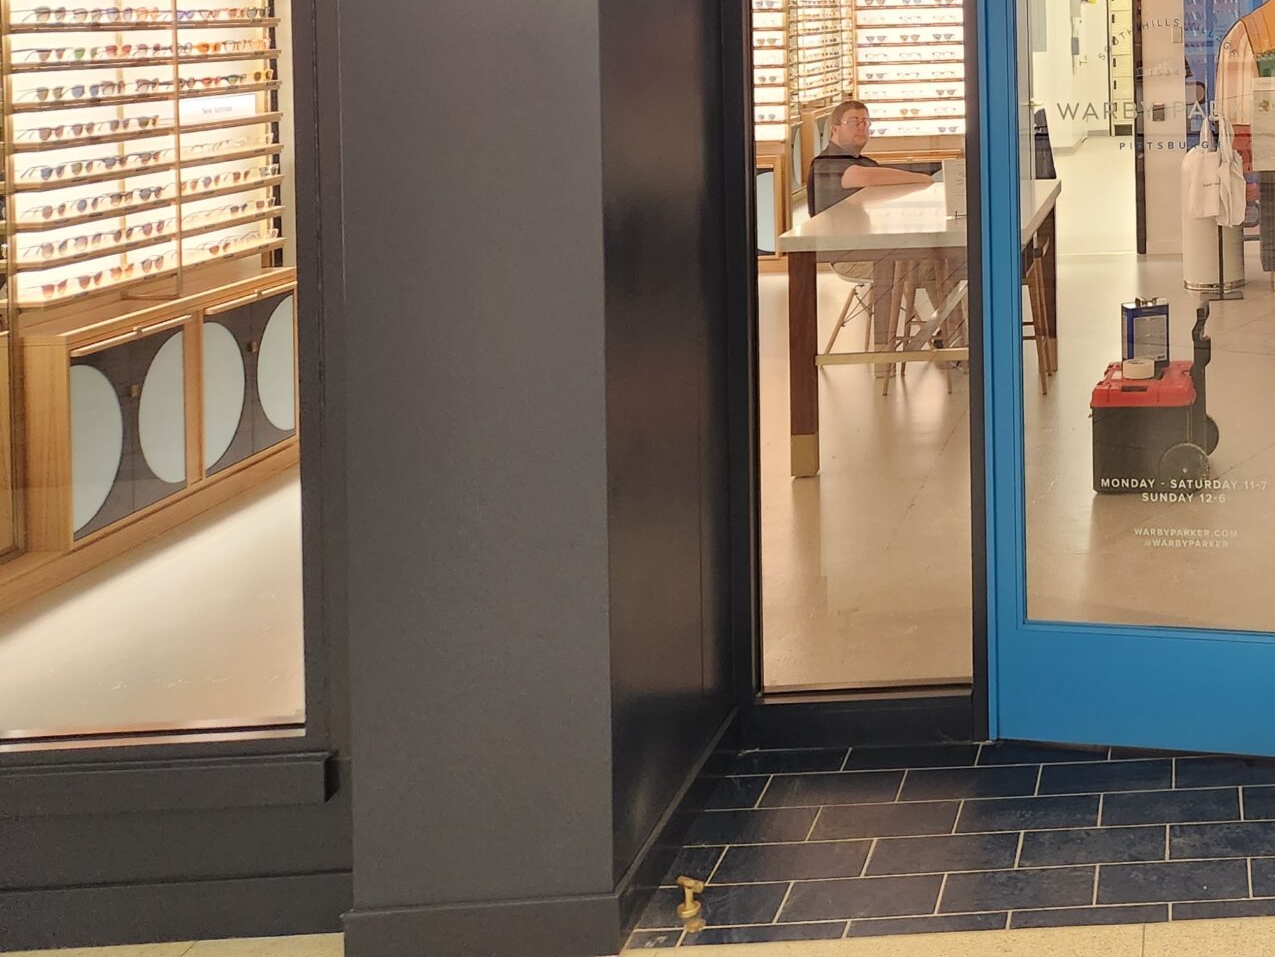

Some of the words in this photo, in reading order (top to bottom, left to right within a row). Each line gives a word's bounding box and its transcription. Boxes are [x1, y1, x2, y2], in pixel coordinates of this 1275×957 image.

[1142, 18, 1180, 29] HILLS
[1056, 102, 1152, 121] WARBY
[1100, 478, 1155, 488] MONDAY
[1170, 478, 1238, 490] SATURDAY
[1244, 480, 1268, 491] 11-7
[1141, 492, 1194, 503] SUNDAY
[1134, 527, 1238, 538] WARBYPARKER.COM
